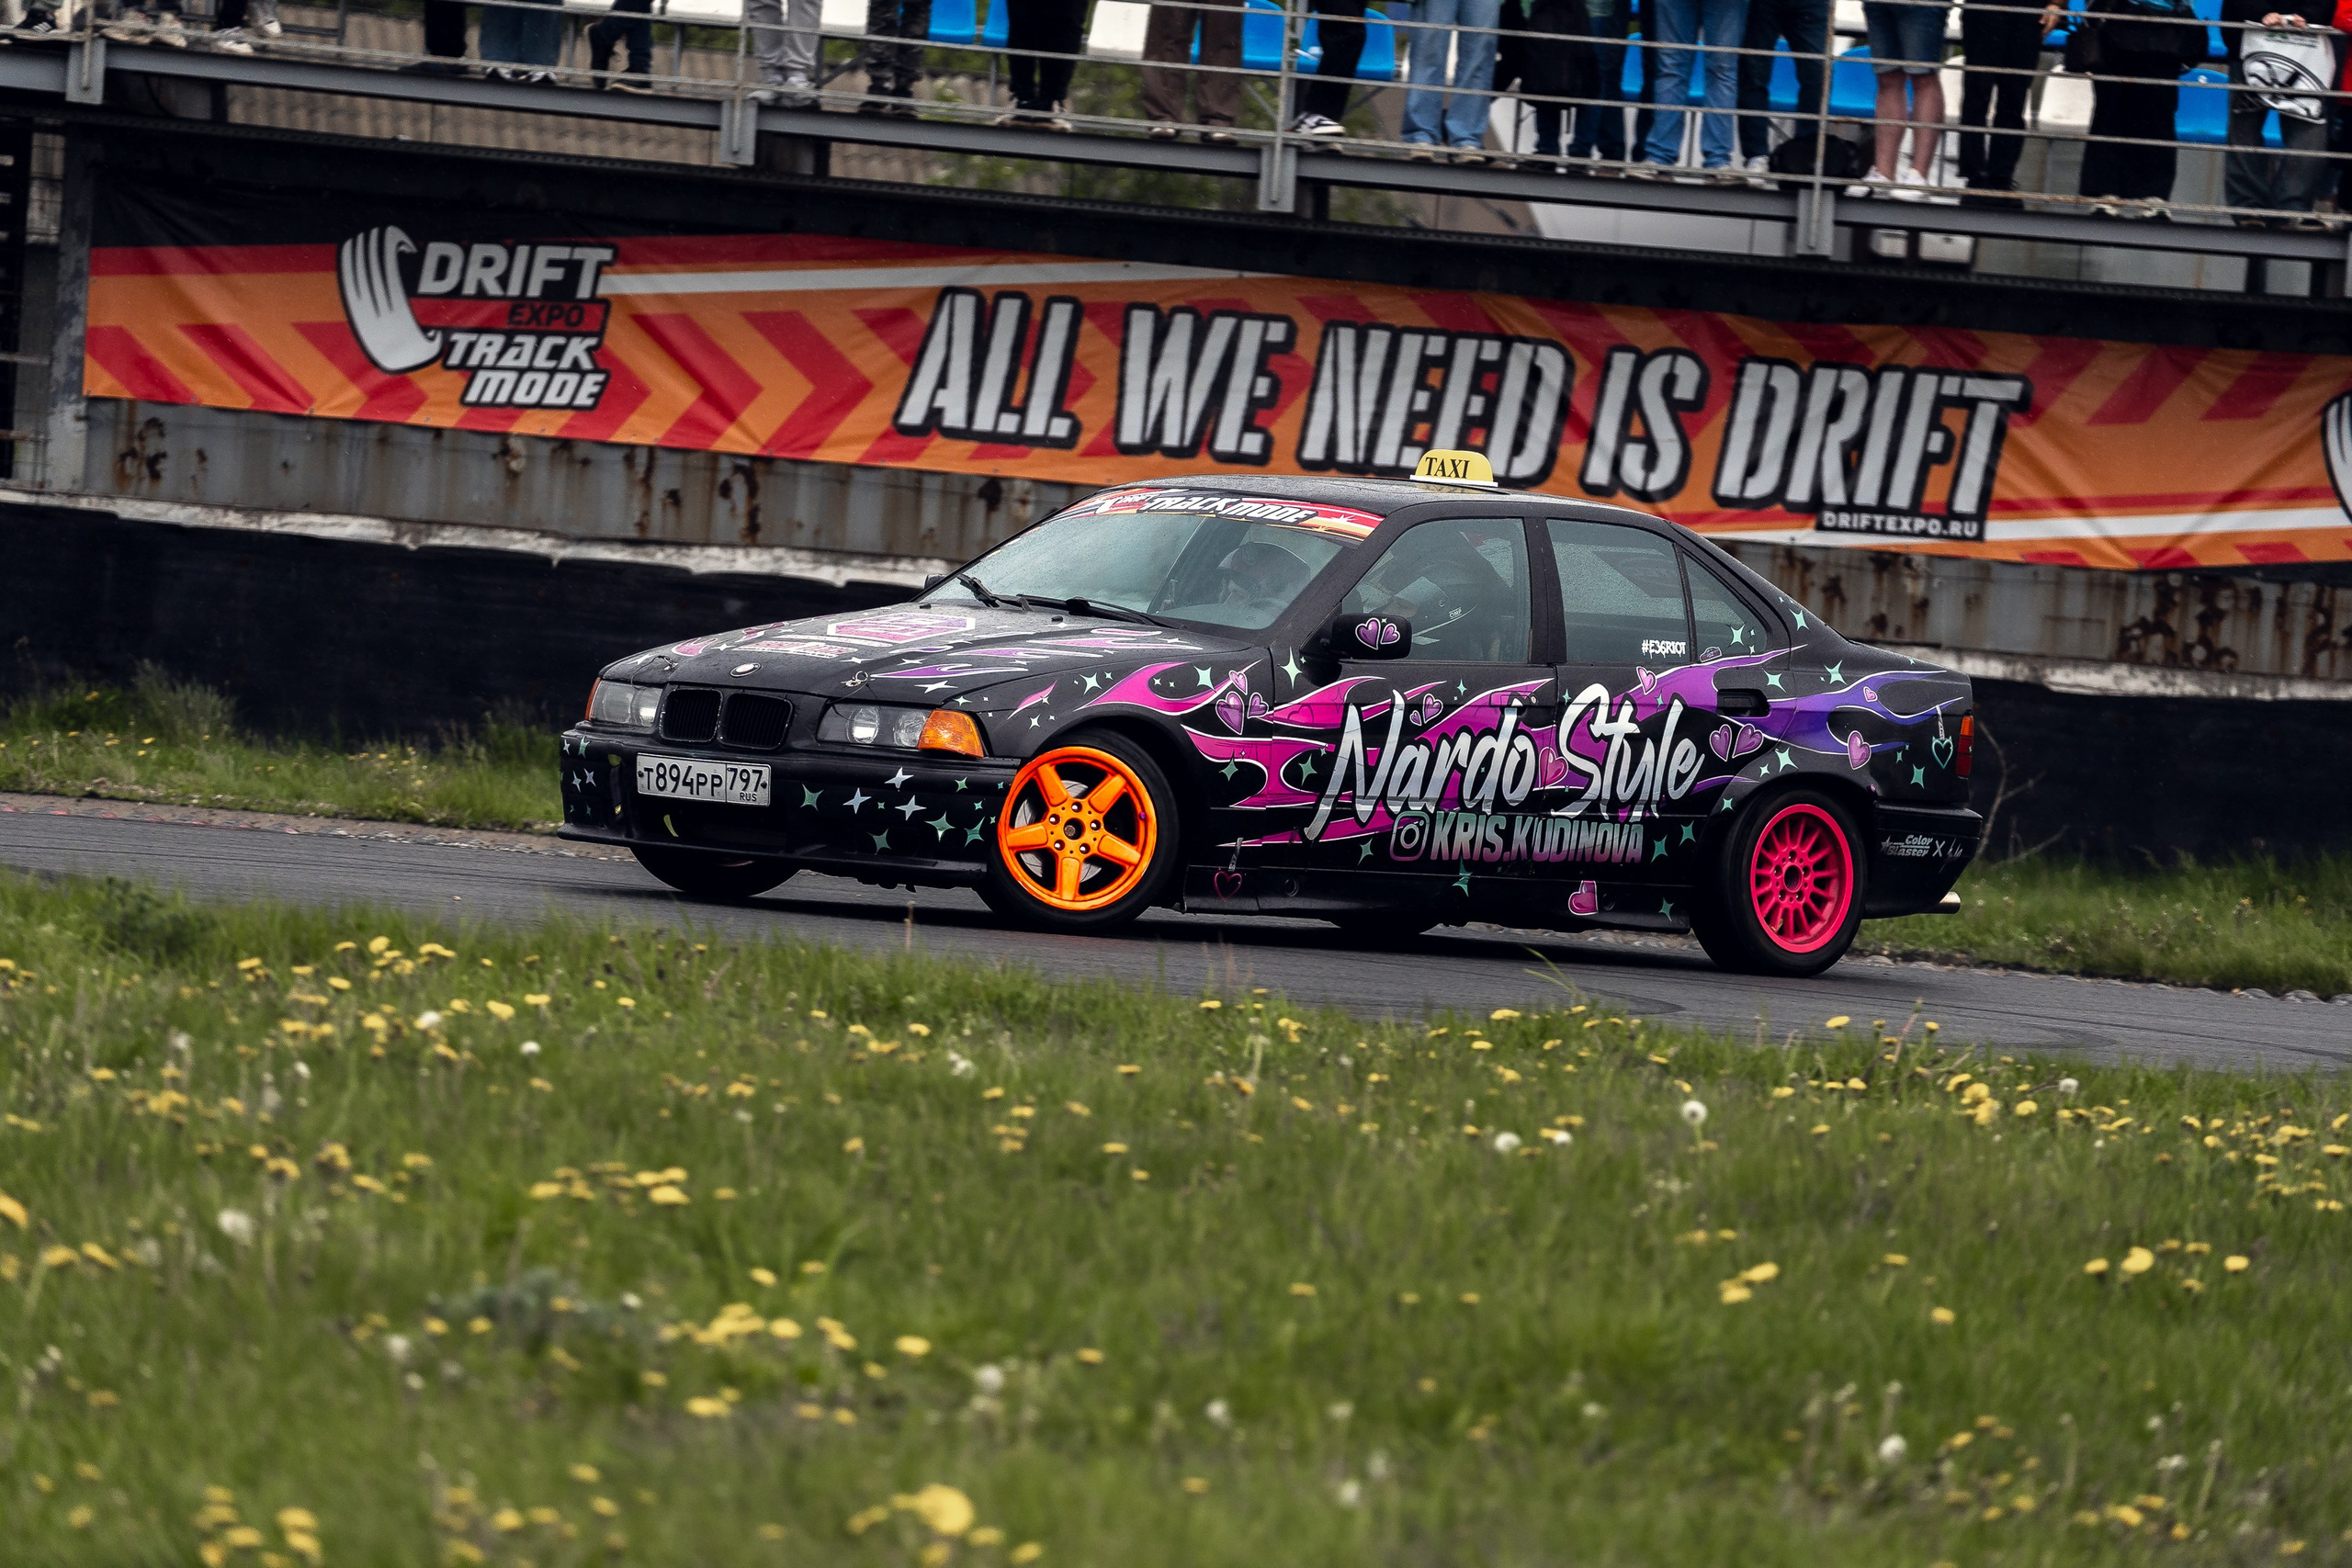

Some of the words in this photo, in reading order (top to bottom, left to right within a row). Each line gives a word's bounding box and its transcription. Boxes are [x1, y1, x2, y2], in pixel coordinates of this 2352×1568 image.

[417, 242, 615, 299] DRIFT
[508, 304, 585, 327] EXPO
[446, 333, 600, 369] TRACK
[463, 369, 607, 407] MODE
[896, 291, 1076, 440] ALL
[1117, 308, 1288, 456] WE
[1300, 326, 1567, 479] NEED
[1583, 351, 1704, 493] IS
[1715, 361, 2026, 515] DRIFT
[1425, 457, 1471, 479] TAXI
[1138, 496, 1241, 512] TRACK
[1224, 502, 1318, 524] MODE
[1821, 510, 1980, 538] DRIFTEXPO.RU
[1641, 639, 1687, 659] #E36RIOT
[1303, 689, 1536, 840] Nardo
[1551, 682, 1706, 822] Style
[728, 767, 763, 793] 797
[740, 792, 758, 802] RUS
[1430, 810, 1645, 863] KRIS.KUDINOVA
[1887, 844, 1930, 857] Blaster
[1905, 834, 1933, 846] Color
